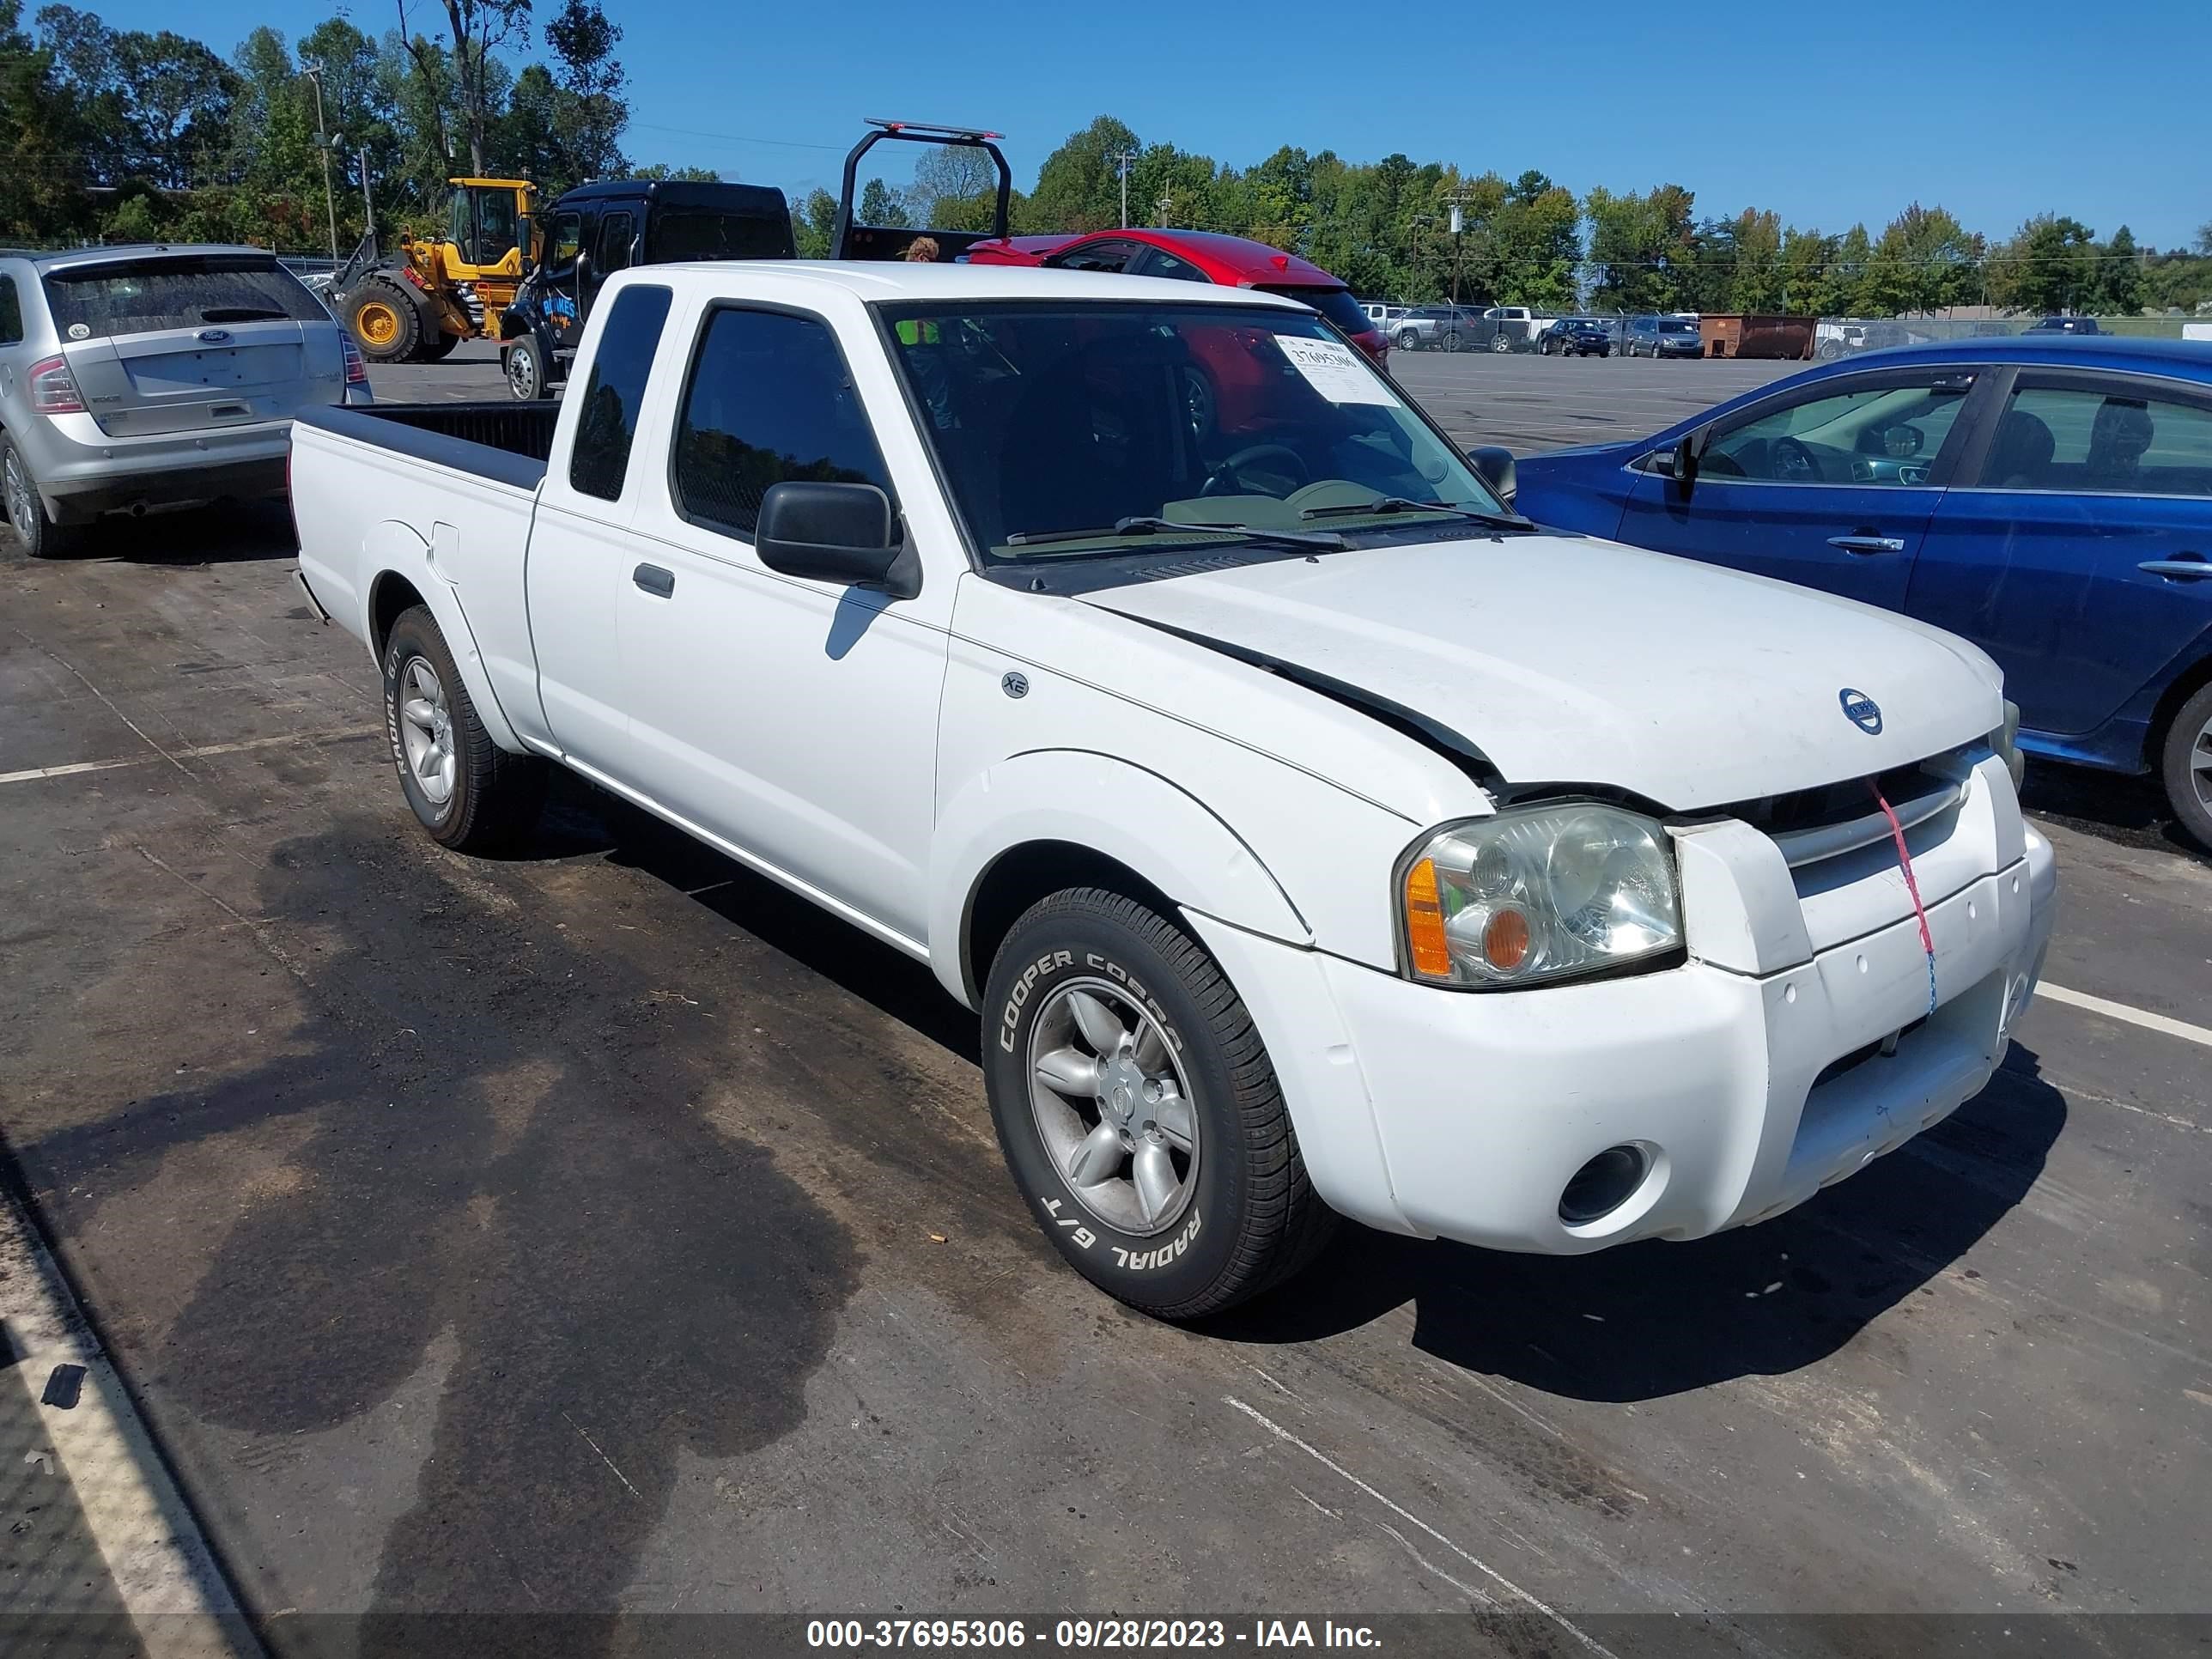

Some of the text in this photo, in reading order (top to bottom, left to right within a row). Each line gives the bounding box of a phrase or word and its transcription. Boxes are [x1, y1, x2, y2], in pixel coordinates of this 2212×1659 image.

[1291, 349, 1358, 368] 37695306
[386, 646, 408, 775] RADIAL G/T
[1003, 676, 1027, 695] XE
[1000, 950, 1183, 1053] COOPER COBRA
[1040, 1196, 1202, 1270] RADIAL G/T
